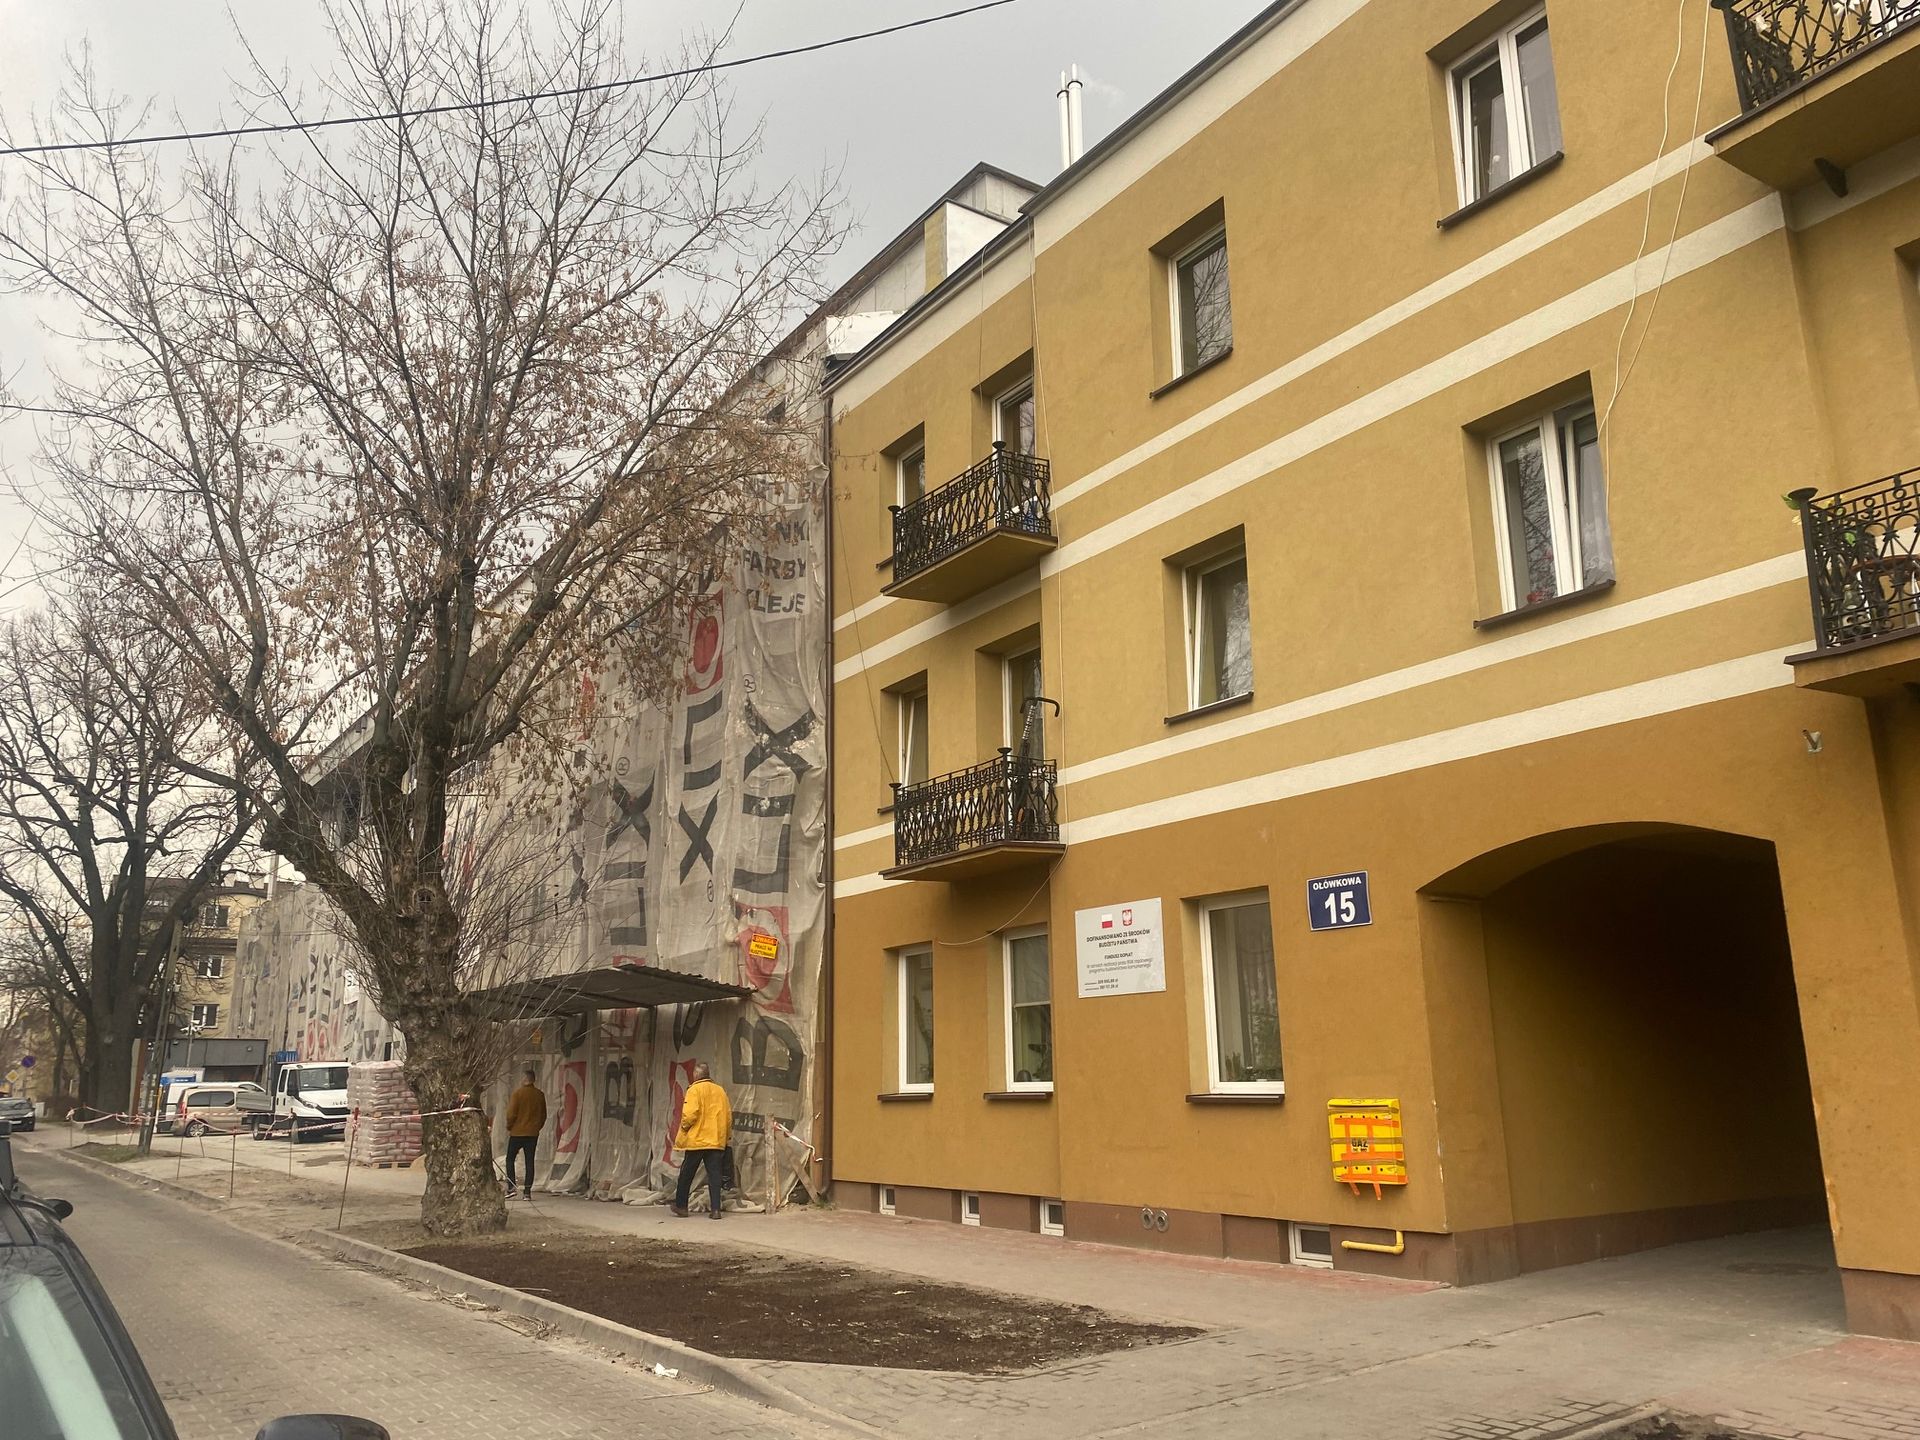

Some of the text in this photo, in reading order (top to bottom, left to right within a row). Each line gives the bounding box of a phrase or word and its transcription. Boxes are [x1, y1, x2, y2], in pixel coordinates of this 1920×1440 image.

[743, 549, 807, 581] FARBY
[1312, 877, 1362, 890] OŁÓWKOWA
[1325, 891, 1356, 924] 15
